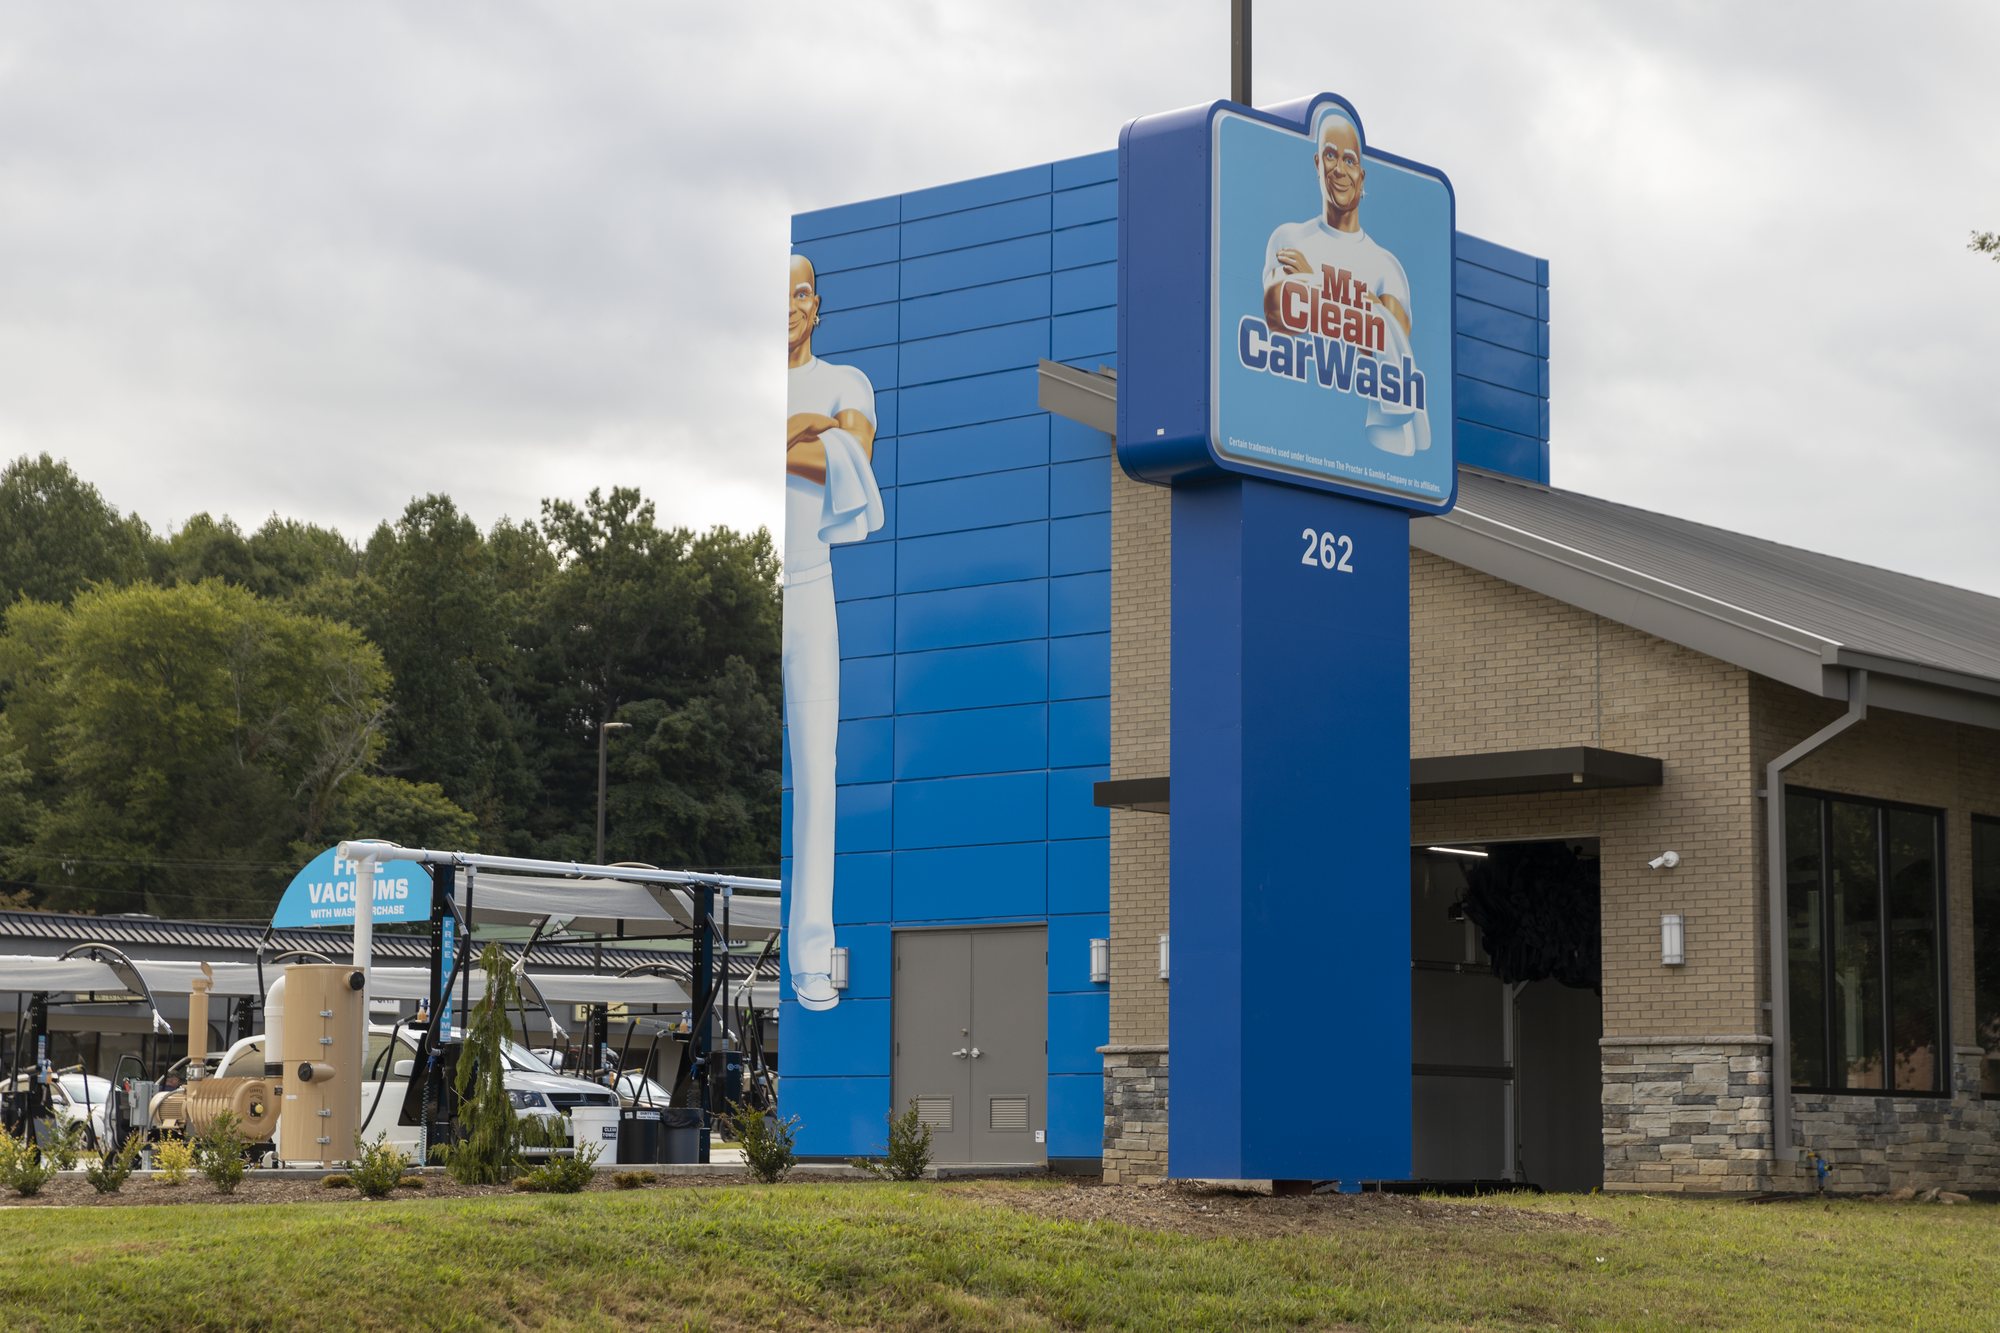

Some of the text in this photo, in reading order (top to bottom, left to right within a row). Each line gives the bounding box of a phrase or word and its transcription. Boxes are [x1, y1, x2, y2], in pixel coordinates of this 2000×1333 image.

[1321, 263, 1372, 312] Mr.
[1281, 280, 1385, 352] Clean
[1228, 436, 1248, 449] Certain
[1248, 442, 1277, 454] trademarks
[1278, 448, 1290, 459] used
[1291, 450, 1305, 461] under
[1306, 454, 1323, 465] license
[1324, 457, 1335, 468] from
[1336, 460, 1345, 471] The
[1345, 462, 1363, 474] Procter
[1369, 468, 1386, 480] Gamble
[1387, 472, 1407, 487] Company
[1408, 478, 1413, 487] or
[1301, 527, 1353, 573] 262
[333, 856, 384, 876] FRE
[308, 879, 408, 904] VACUMS
[310, 908, 332, 919] WITH
[444, 920, 453, 959] FREE
